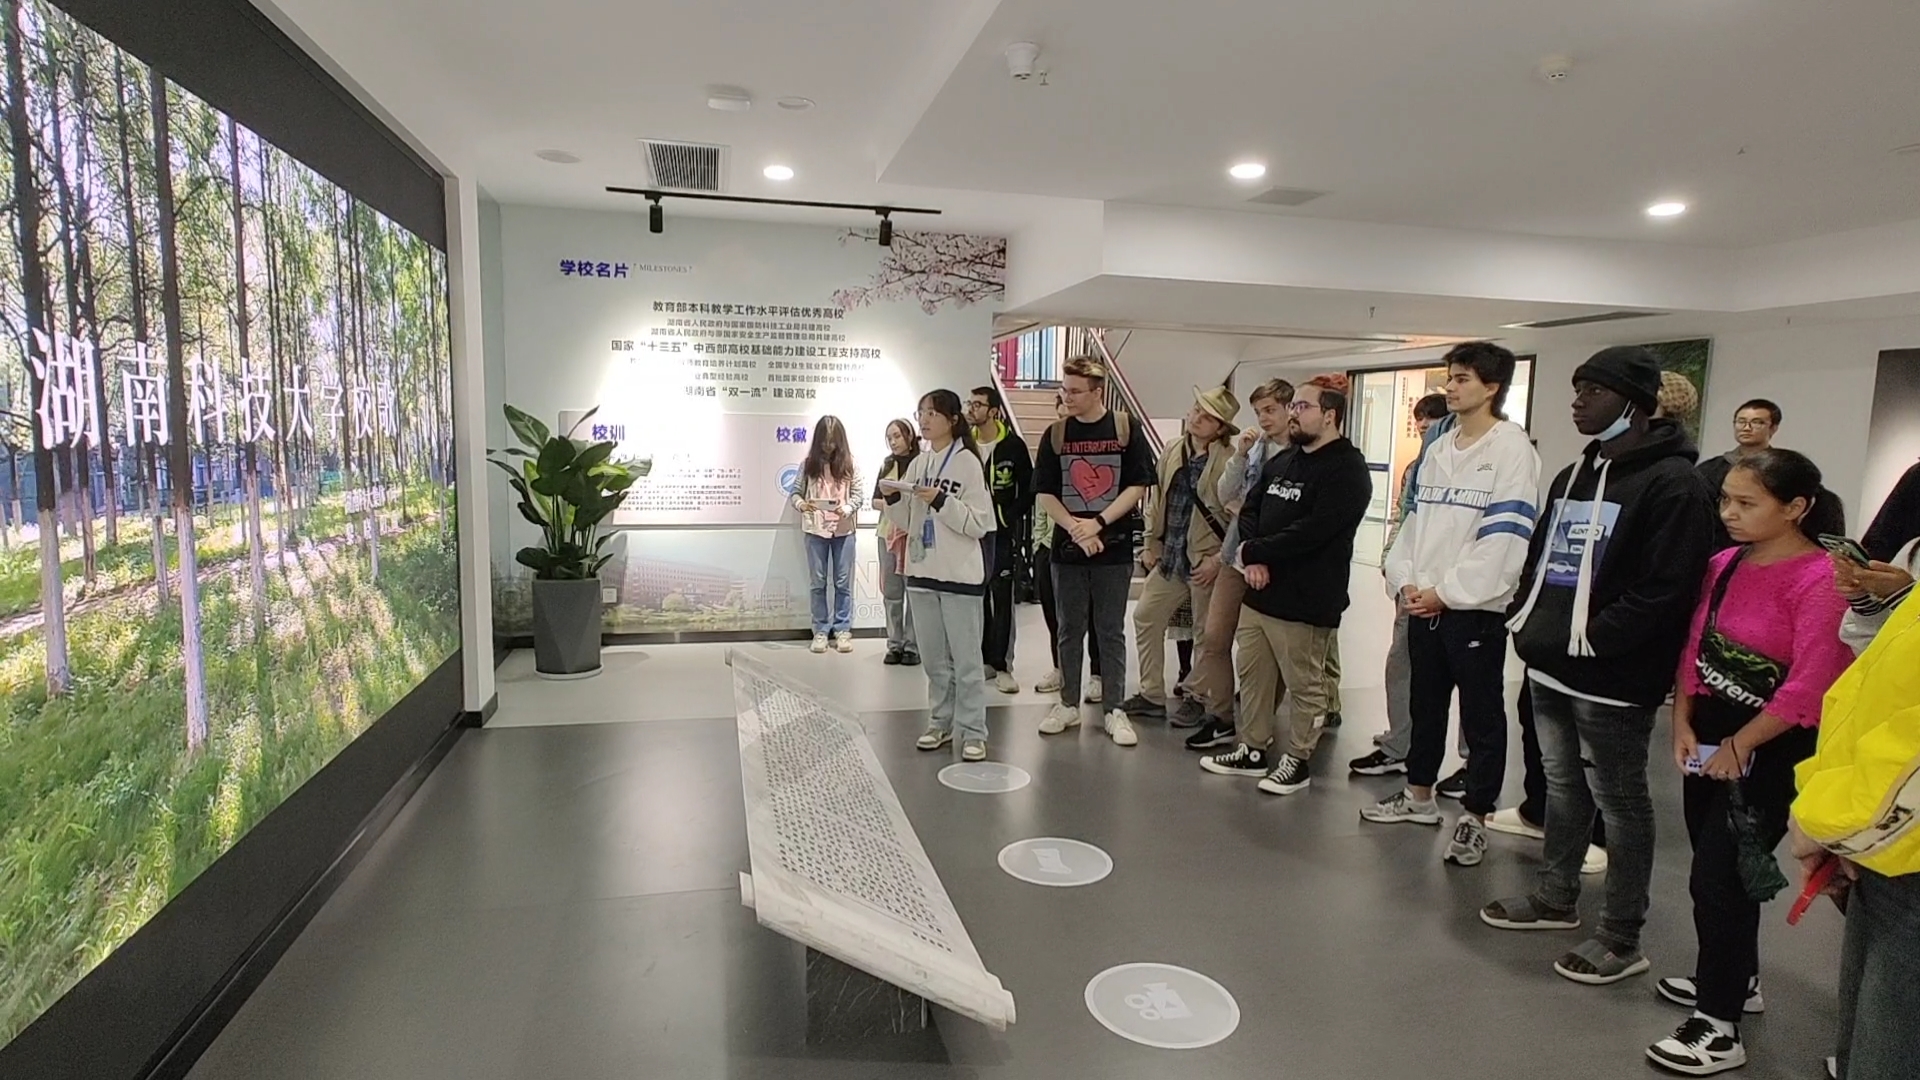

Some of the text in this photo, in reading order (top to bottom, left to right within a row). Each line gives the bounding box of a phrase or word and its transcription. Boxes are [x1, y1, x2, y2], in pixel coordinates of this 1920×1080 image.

[560, 259, 629, 278] 学校名片
[653, 301, 844, 319] 教育部本科教学工作水平评估优秀高校
[31, 327, 397, 449] 湖南科技大学校歌
[592, 423, 625, 441] 校训
[776, 426, 807, 443] 校徽
